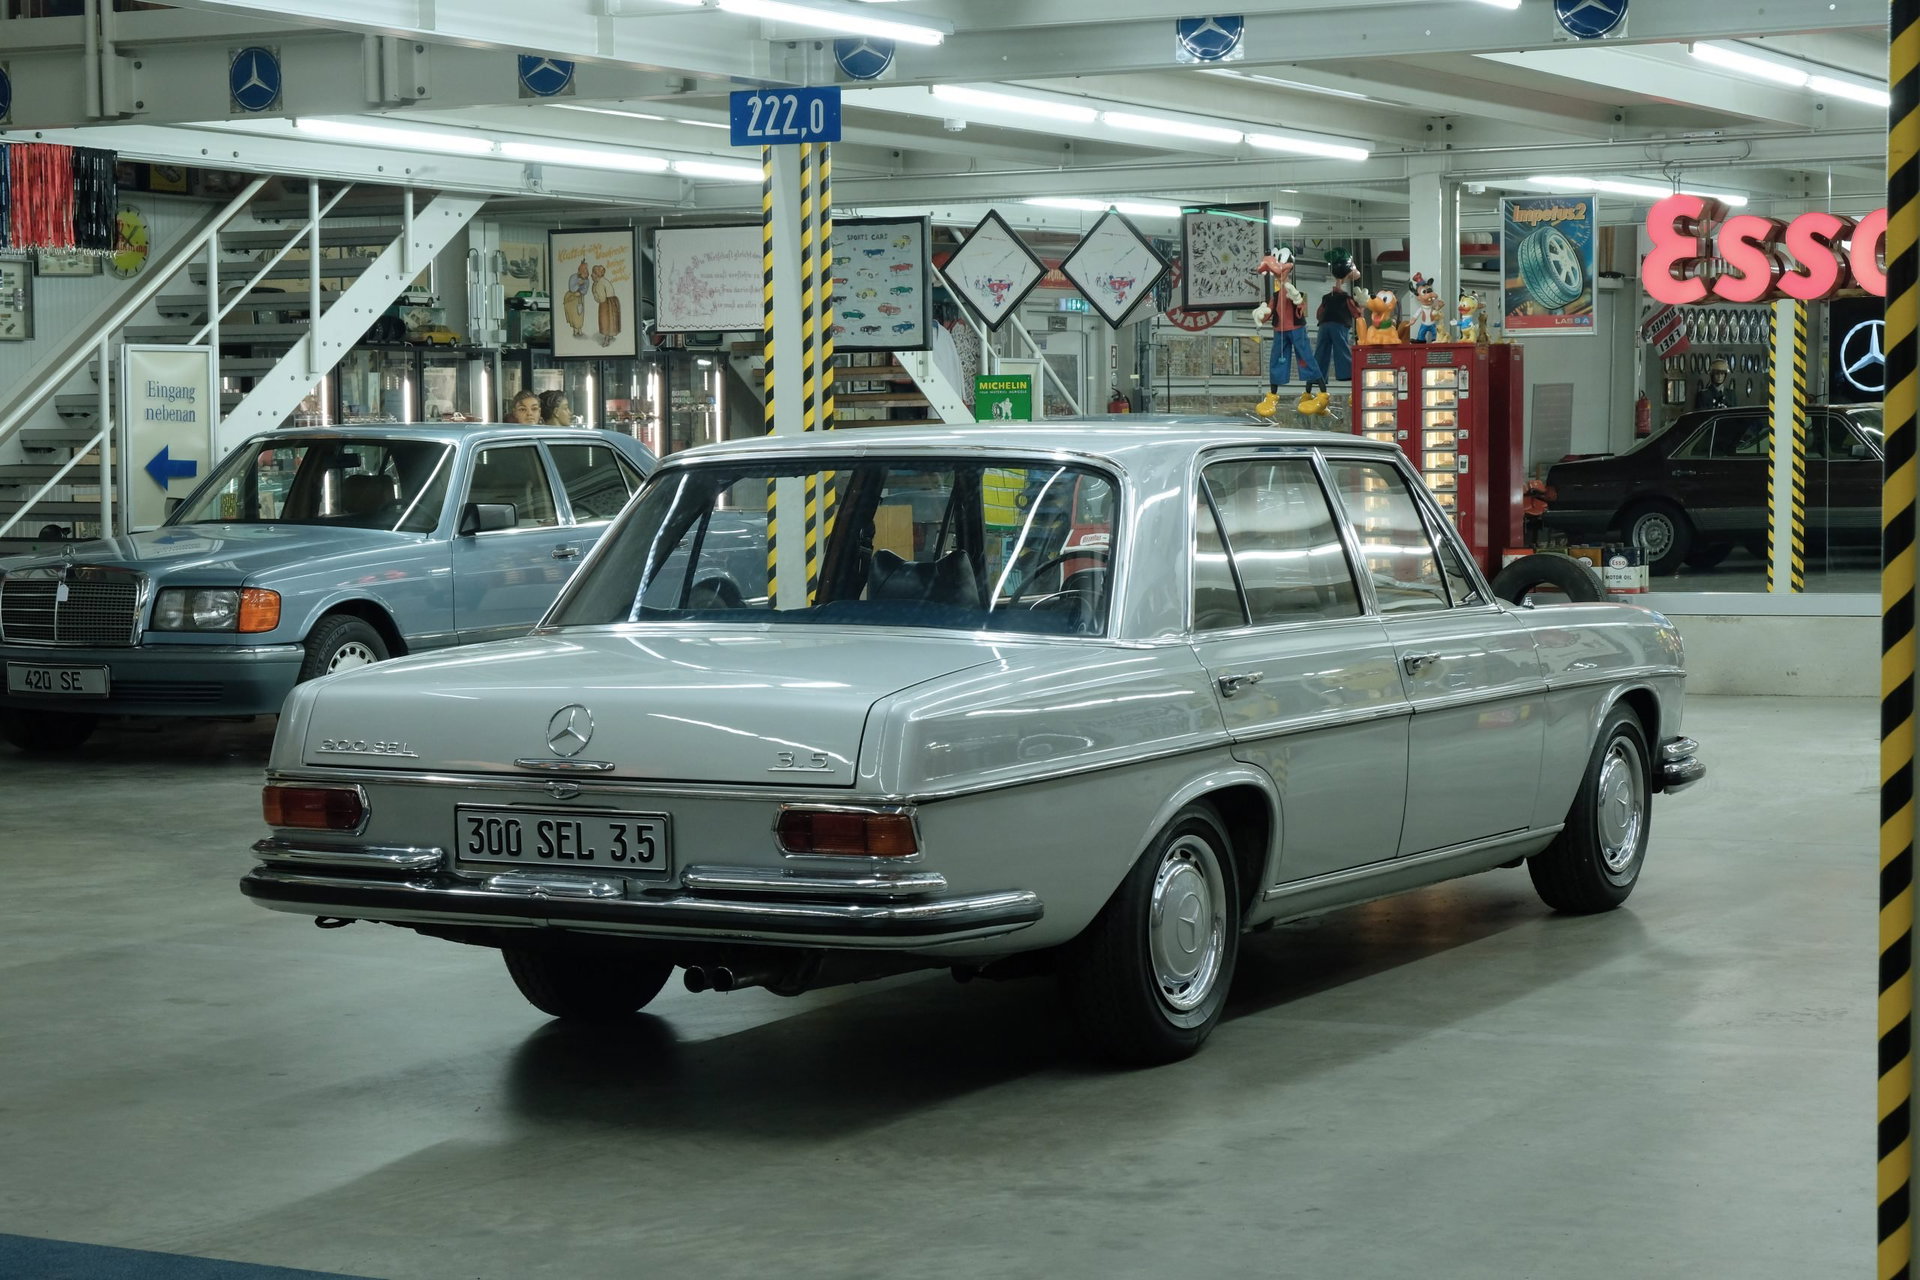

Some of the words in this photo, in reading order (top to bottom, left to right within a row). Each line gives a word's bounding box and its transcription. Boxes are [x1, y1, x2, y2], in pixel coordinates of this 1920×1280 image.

[747, 94, 824, 139] 222,0
[871, 233, 888, 241] CARS
[147, 380, 196, 404] Eingang
[979, 381, 1027, 390] MICHELIN
[146, 404, 196, 423] nebenan
[25, 670, 52, 690] 420
[60, 671, 84, 691] SE
[321, 739, 367, 751] 300
[373, 741, 414, 754] SEL
[775, 751, 828, 769] 3.5
[467, 817, 522, 857] 300
[537, 820, 595, 860] SEL
[609, 823, 656, 863] 3.5
